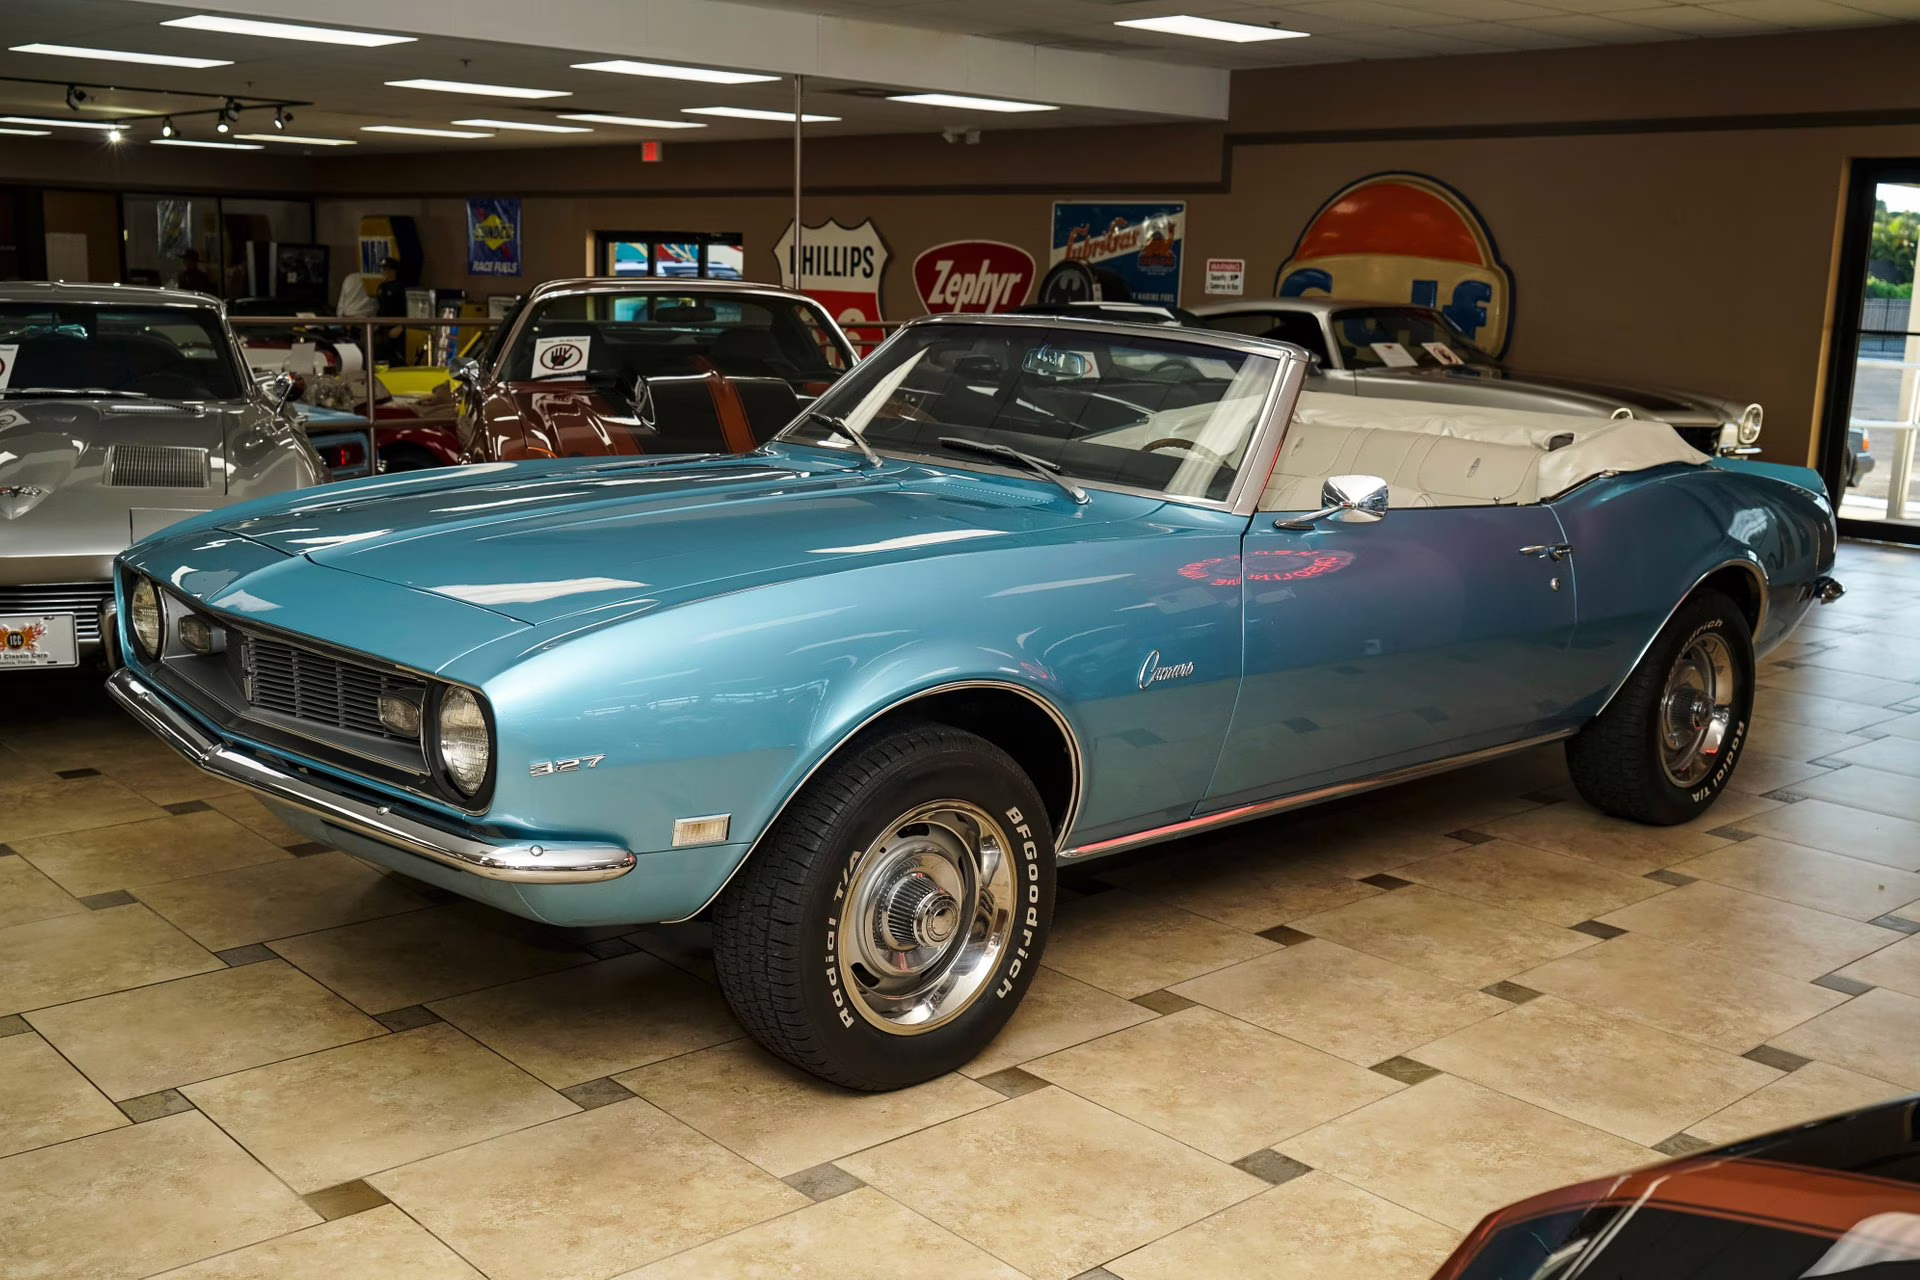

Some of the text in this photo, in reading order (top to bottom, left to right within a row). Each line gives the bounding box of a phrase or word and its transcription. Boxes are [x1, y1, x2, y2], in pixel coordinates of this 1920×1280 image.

[472, 260, 518, 273] RACE FUELS
[927, 259, 1023, 314] Zephyr
[1210, 263, 1240, 271] WARNING
[1137, 650, 1194, 689] Camaro
[529, 754, 606, 777] 327
[1691, 720, 1744, 803] Radial T/A
[996, 806, 1039, 999] BFGoodrich
[825, 850, 862, 1029] Radial T/A
